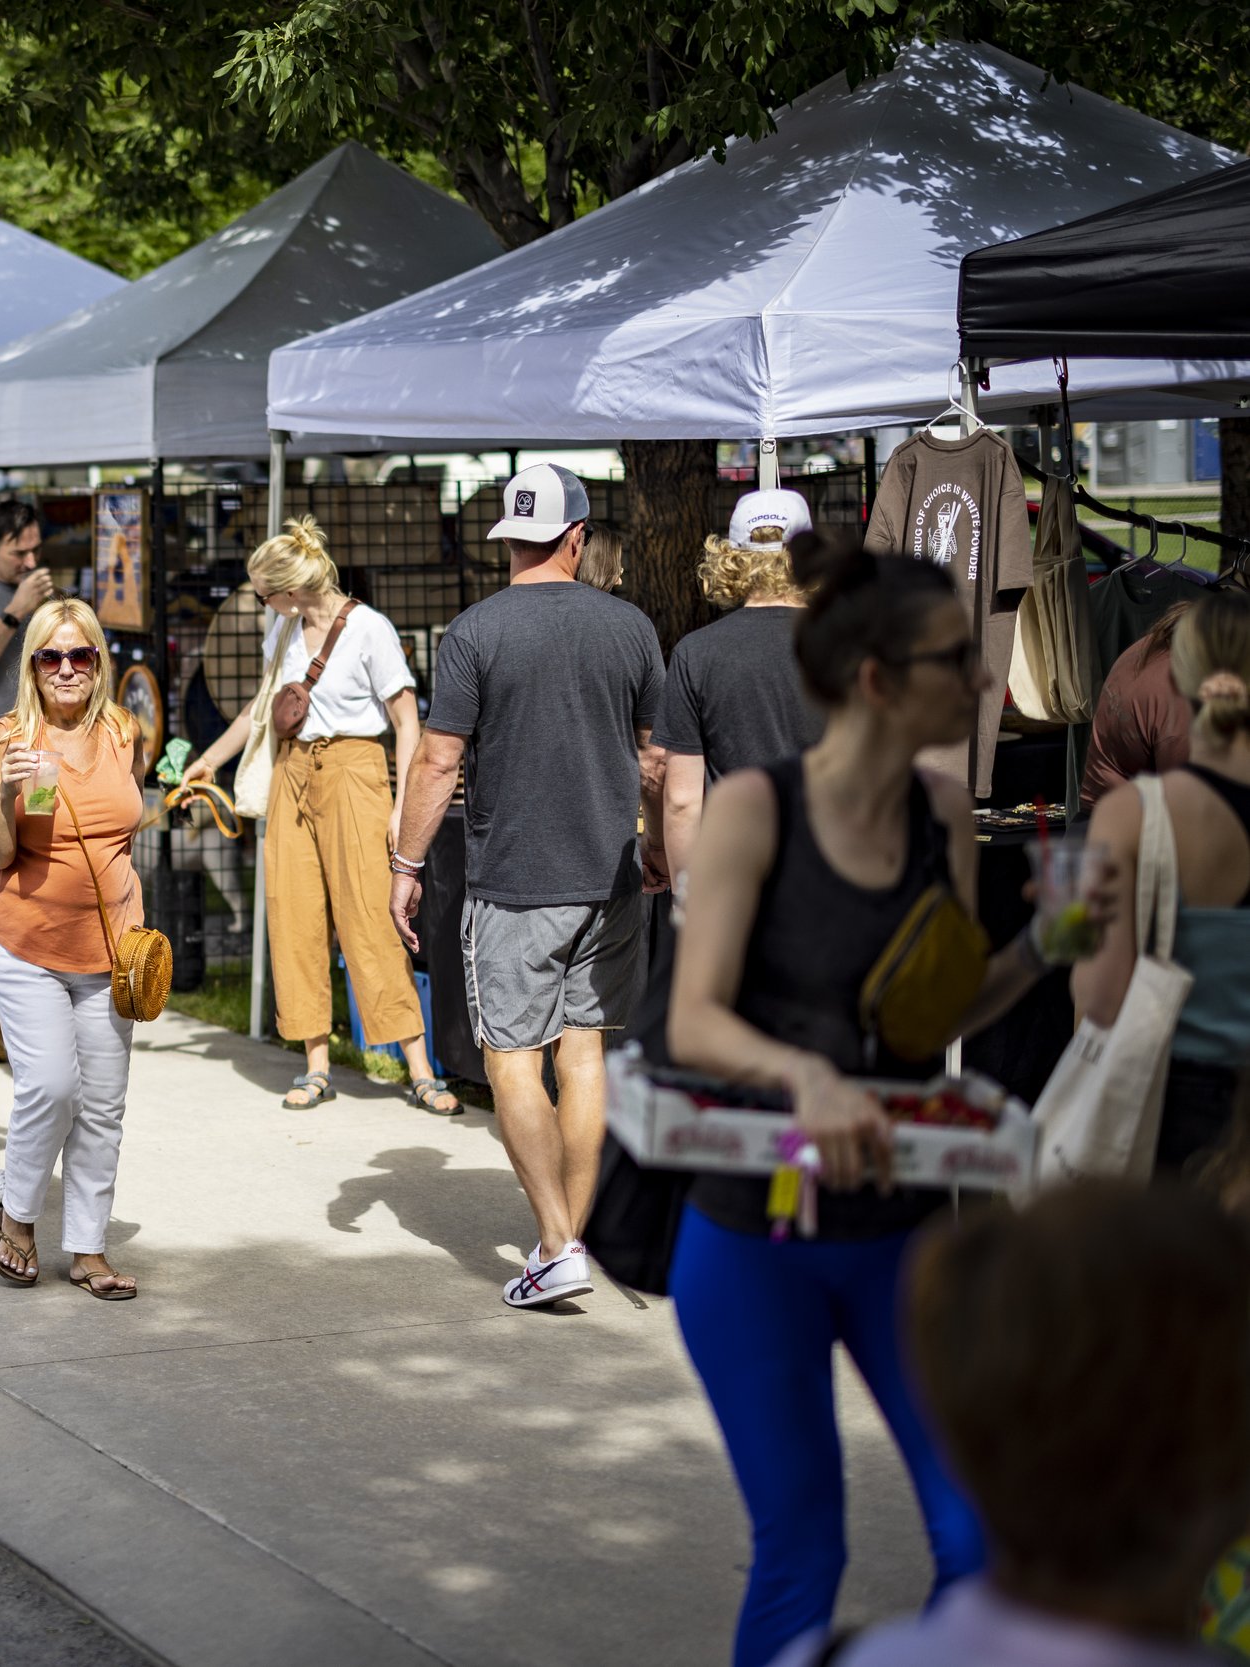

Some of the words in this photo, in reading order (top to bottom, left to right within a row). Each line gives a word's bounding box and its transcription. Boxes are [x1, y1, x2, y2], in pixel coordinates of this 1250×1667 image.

[923, 483, 952, 509] CHOICE
[953, 484, 961, 495] IS
[916, 509, 926, 525] OF
[960, 490, 981, 528] WHITE
[914, 528, 923, 560] DRUG
[967, 530, 981, 580] POWDER
